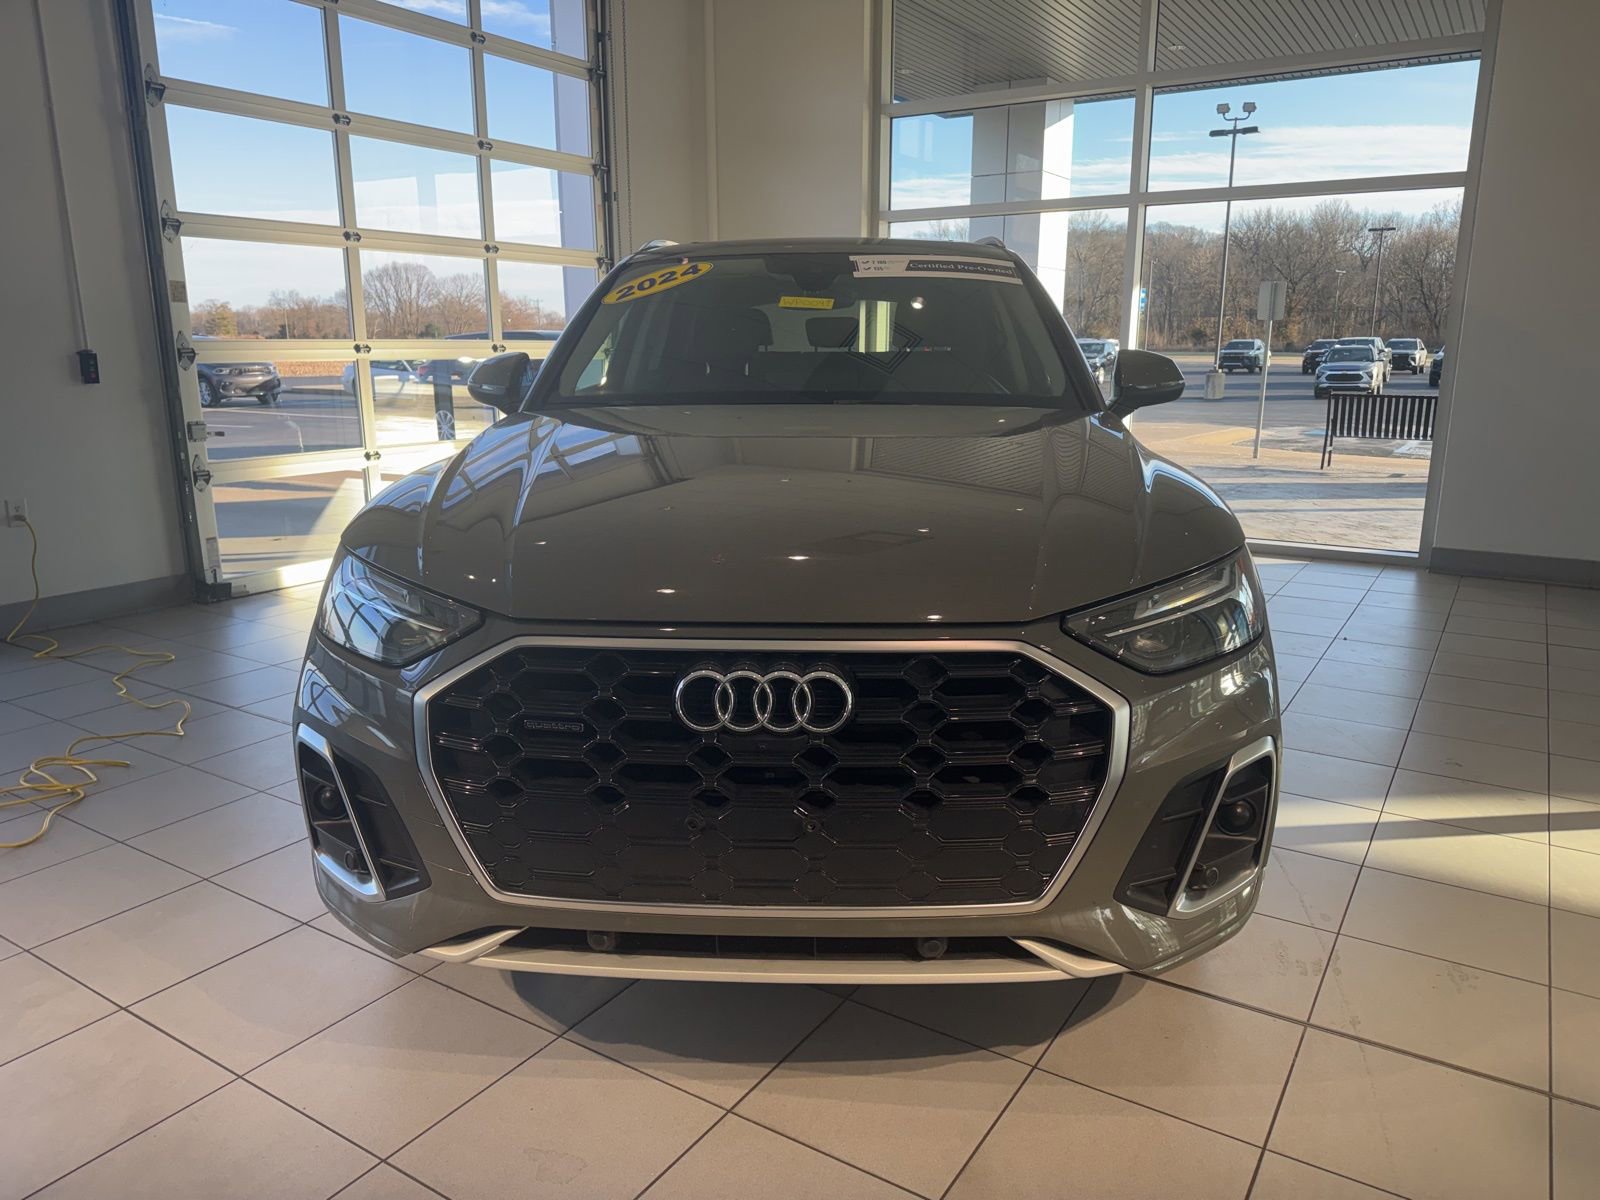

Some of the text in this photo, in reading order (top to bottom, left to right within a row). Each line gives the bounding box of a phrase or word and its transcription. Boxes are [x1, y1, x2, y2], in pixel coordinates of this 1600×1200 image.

[909, 262, 1013, 275] Certified Pre-Owned
[616, 264, 702, 301] 2024
